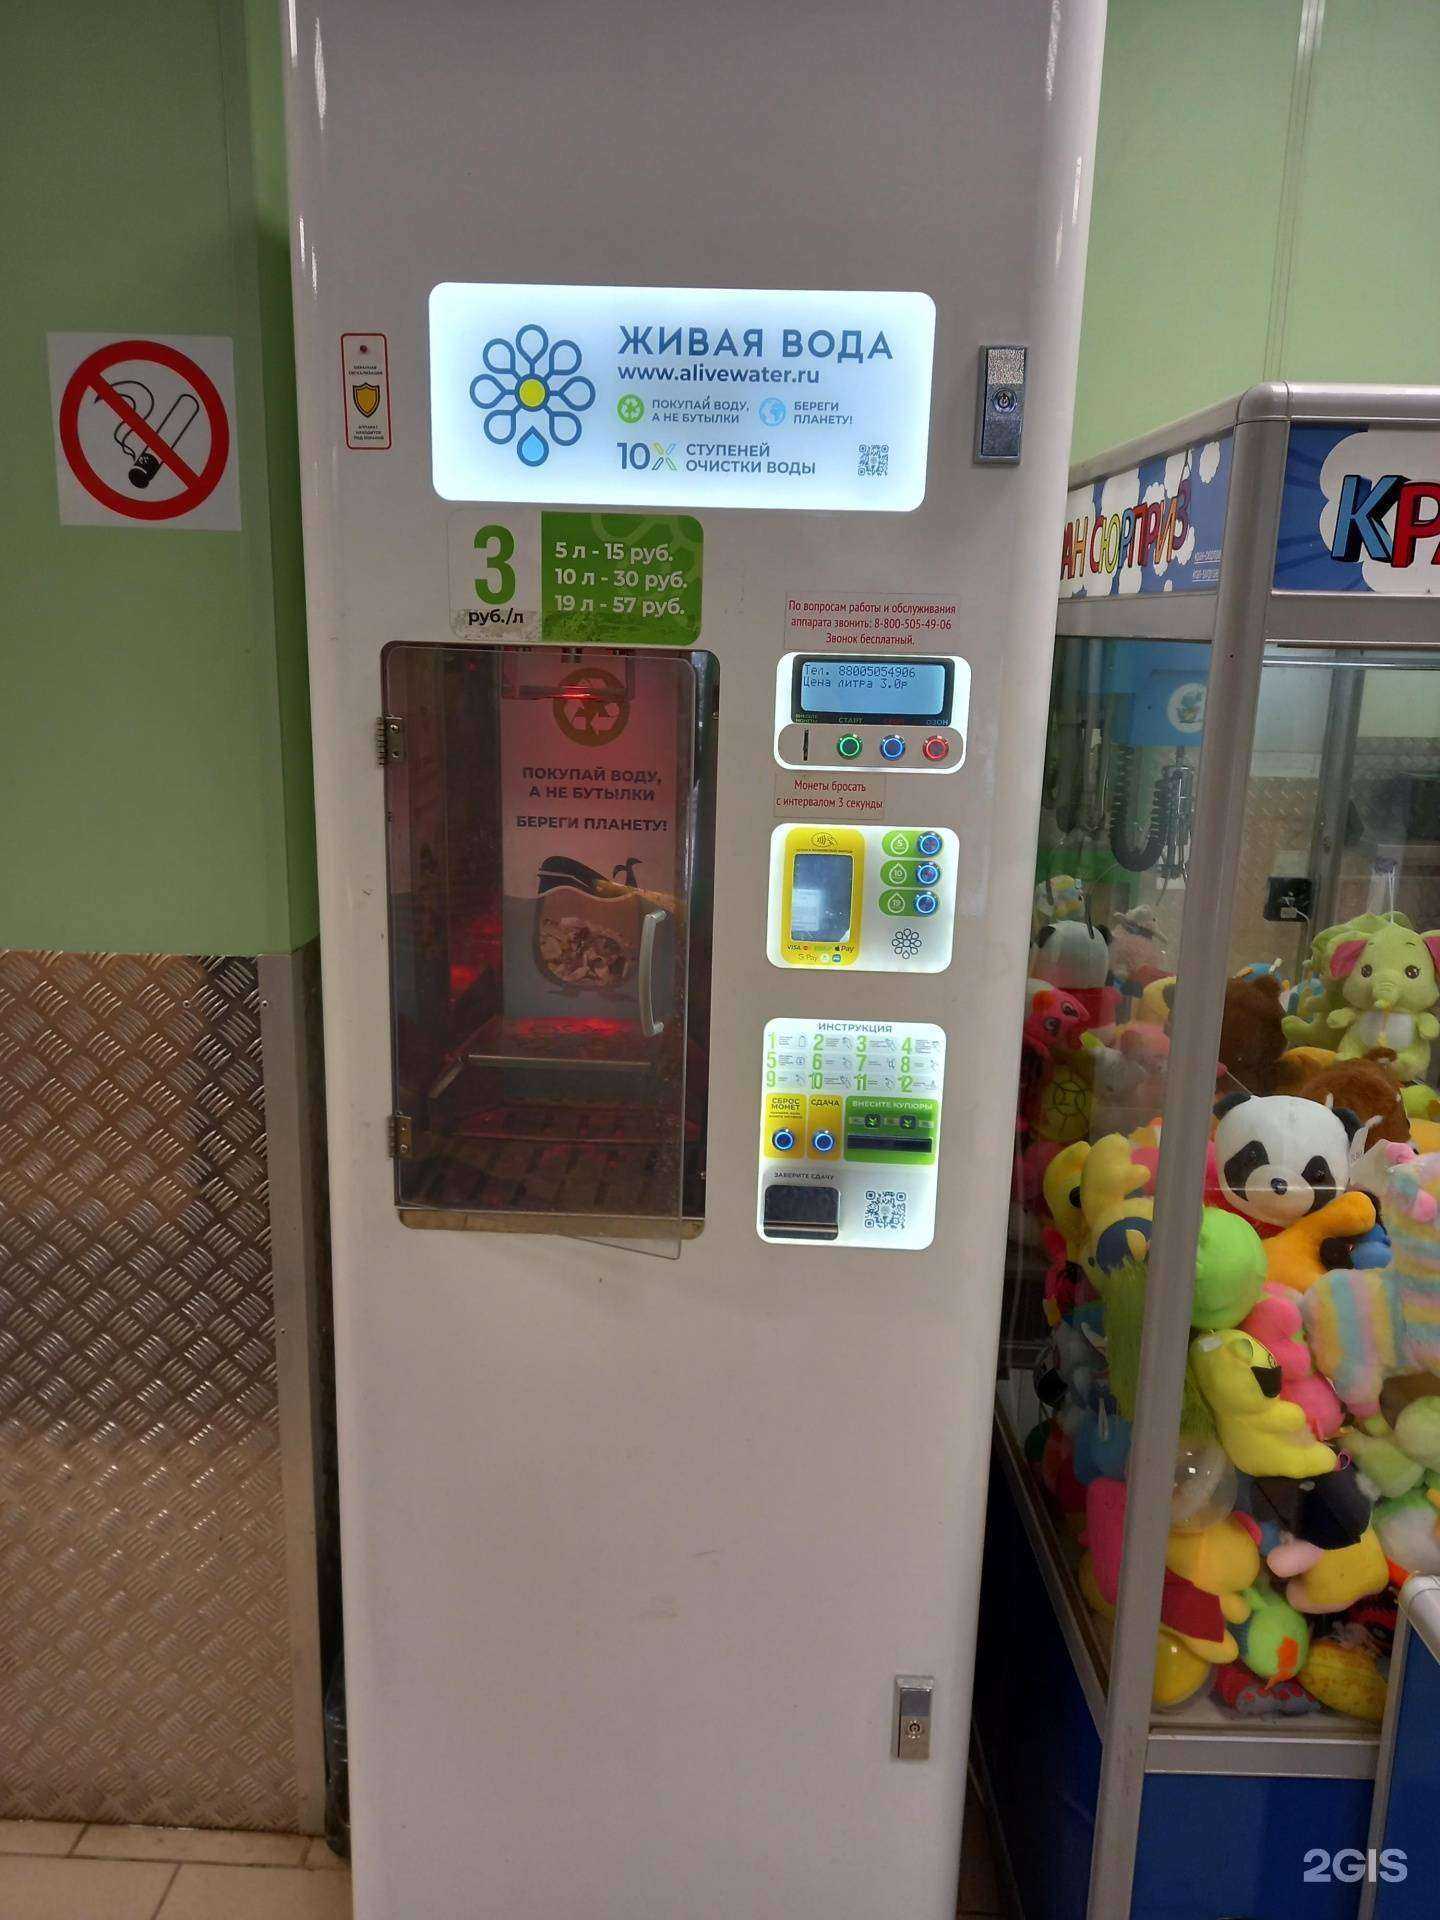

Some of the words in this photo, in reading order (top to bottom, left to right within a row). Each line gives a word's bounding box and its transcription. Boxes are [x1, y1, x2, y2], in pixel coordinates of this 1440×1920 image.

[618, 325, 763, 357] ЖИВАЯ
[782, 329, 893, 363] ВОДА
[618, 363, 820, 383] www.alivewater.ru
[652, 395, 710, 410] ПОКУПАЙ
[714, 401, 750, 412] ВОДУ,
[794, 401, 839, 412] БЕРЕГИ
[652, 413, 660, 422] А
[663, 413, 679, 422] НЕ
[682, 413, 739, 424] БУТЫЛКИ
[794, 414, 853, 425] ПЛАНЕТУ!
[686, 442, 770, 457] СТУПЕНЕЙ
[686, 460, 762, 473] ОЧИСТКИ
[767, 461, 816, 476] ВОДЫ
[1060, 516, 1089, 580] АН
[1090, 479, 1191, 574] СЮРПРИЗ
[1331, 474, 1440, 568] КР
[555, 542, 567, 559] 5
[572, 545, 586, 559] л
[604, 543, 624, 560] 15
[630, 545, 673, 564] руб.
[474, 524, 516, 605] 3
[555, 568, 576, 585] 10
[581, 571, 595, 585] л
[613, 570, 639, 587] 30
[645, 571, 688, 591] руб.
[555, 594, 575, 611] 19
[580, 598, 594, 612] л
[612, 596, 637, 614] 57
[642, 597, 685, 617] руб.
[789, 600, 801, 611] По
[803, 602, 846, 614] вопросам
[849, 602, 880, 614] работы
[892, 603, 956, 615] обслуживания
[468, 608, 524, 625] руб./л
[791, 619, 832, 629] аппарата
[874, 618, 952, 630] 8-800-505-49-06
[826, 633, 858, 643] Звонок
[804, 664, 829, 676] Тел.
[838, 665, 916, 678] 88005054906
[803, 676, 831, 688] Цена
[838, 680, 873, 689] литра
[522, 766, 606, 780] ПОКУПАЙ
[611, 770, 662, 784] ВОДУ,
[529, 786, 541, 798] А
[546, 786, 568, 798] НЕ
[573, 787, 655, 801] БУТЫЛКИ
[794, 780, 829, 790] Монеты
[831, 781, 866, 793] бросать
[776, 798, 781, 806] с
[783, 798, 836, 808] интервалом
[838, 797, 844, 808] 3
[847, 800, 883, 810] секунды
[516, 815, 579, 829] БЕРЕГИ
[583, 818, 667, 832] ПЛАНЕТУ!
[818, 1022, 892, 1033] ИНСТРУКЦИЯ
[768, 1032, 776, 1049] 1
[813, 1034, 824, 1051] 2
[857, 1035, 866, 1052] 3
[902, 1037, 912, 1054] 4
[767, 1052, 776, 1068] 5
[812, 1053, 822, 1070] 6
[856, 1054, 867, 1071] 7
[901, 1056, 910, 1073] 8
[767, 1071, 776, 1087] 9
[809, 1072, 823, 1089] 10
[854, 1074, 867, 1091] 11
